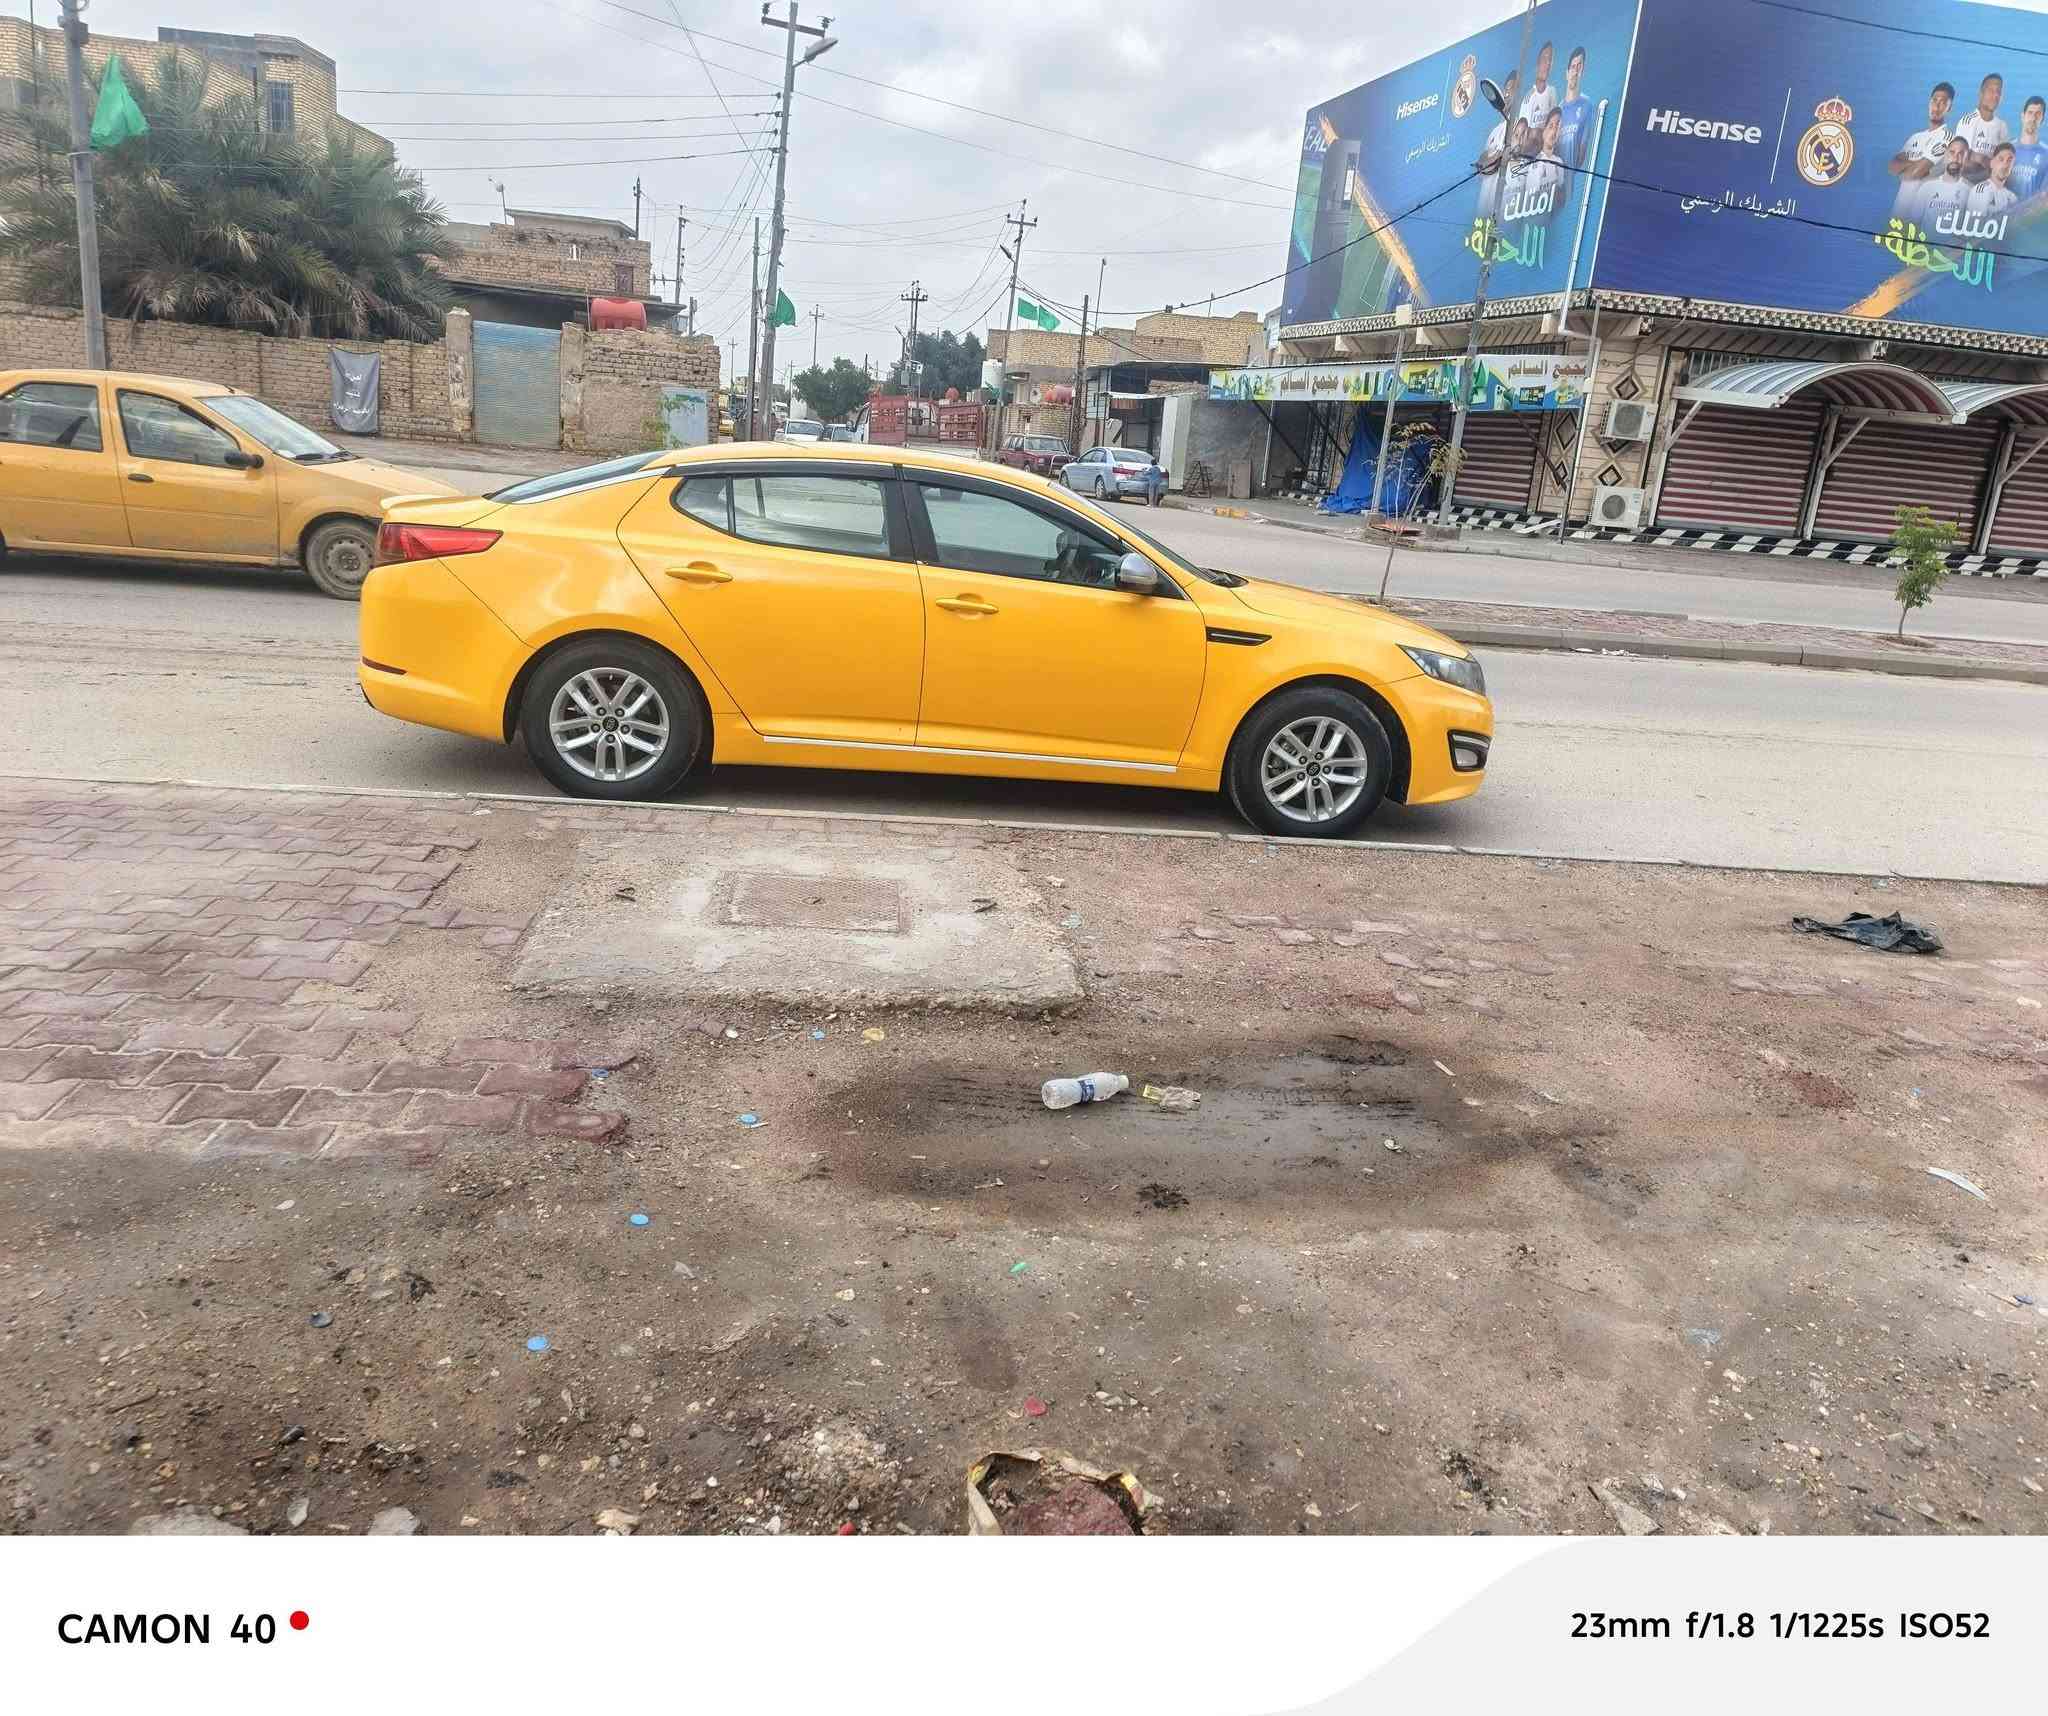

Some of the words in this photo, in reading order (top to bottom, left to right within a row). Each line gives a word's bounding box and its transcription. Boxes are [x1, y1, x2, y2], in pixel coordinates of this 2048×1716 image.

[1395, 93, 1439, 120] Hisense
[1646, 108, 1762, 144] Hisense
[1504, 183, 1556, 221] امتلك
[1681, 190, 1734, 214] الرسمي
[1739, 193, 1796, 218] الشريك
[1936, 211, 2008, 241] امتلك
